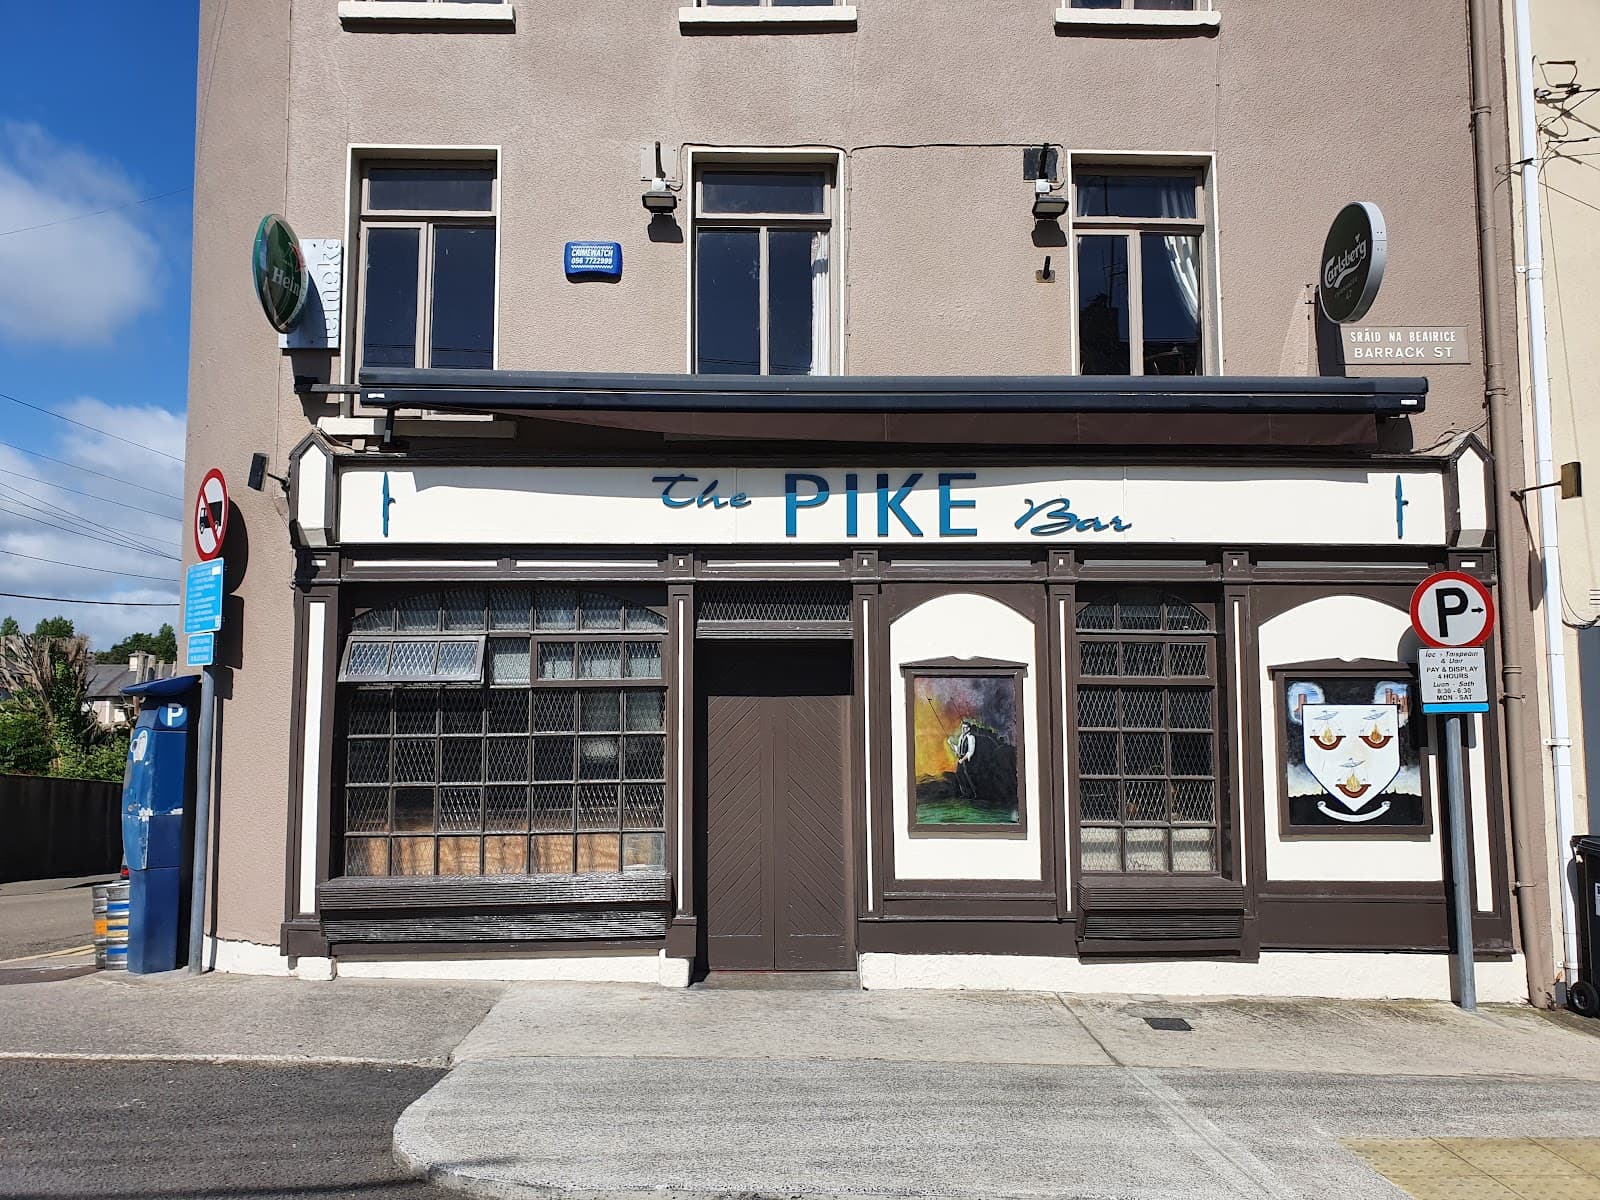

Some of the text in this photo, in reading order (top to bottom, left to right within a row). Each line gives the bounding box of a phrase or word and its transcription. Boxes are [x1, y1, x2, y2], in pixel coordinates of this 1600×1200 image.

[571, 249, 613, 257] CRIMEWATCH
[1324, 239, 1367, 289] Carlsberg
[1350, 328, 1457, 343] SRÁID NA BEAIRICE
[1354, 346, 1454, 359] BARRACK ST
[785, 473, 978, 538] PIKE
[1014, 498, 1132, 537] Bar
[1435, 587, 1469, 637] P
[167, 703, 183, 727] P
